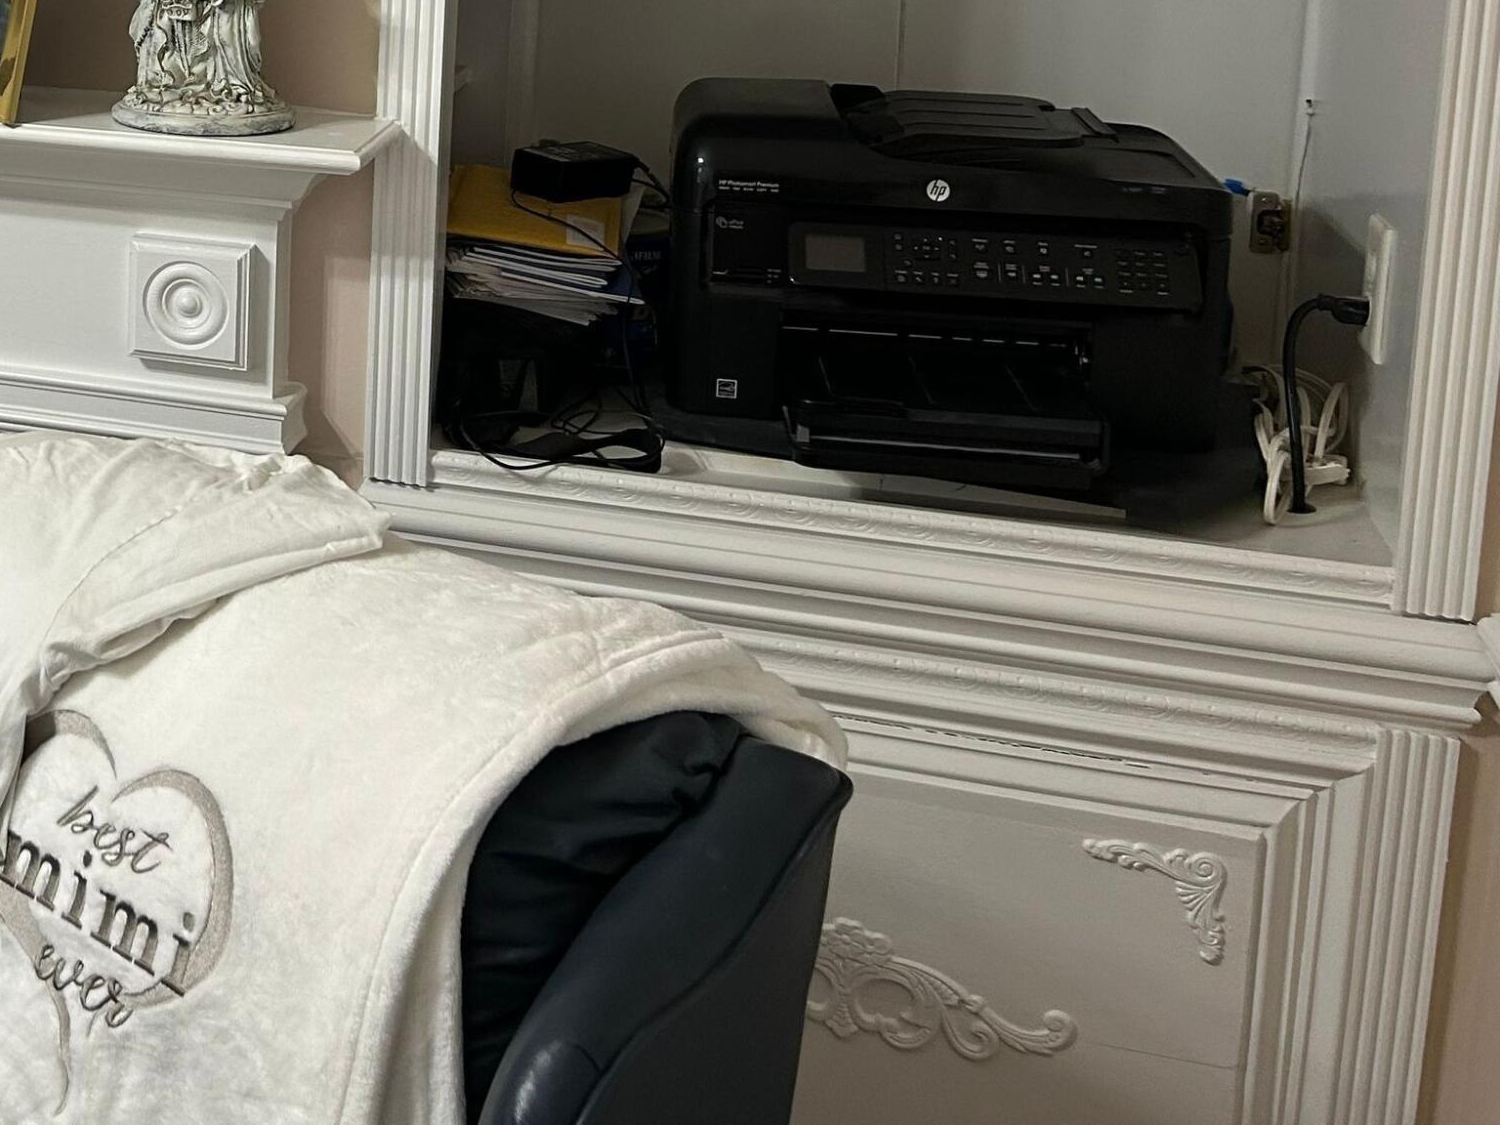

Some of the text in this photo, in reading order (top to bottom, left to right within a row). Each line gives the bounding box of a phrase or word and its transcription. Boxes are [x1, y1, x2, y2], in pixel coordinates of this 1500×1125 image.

[927, 179, 950, 202] hp
[57, 785, 172, 874] best
[34, 944, 134, 1028] ever
